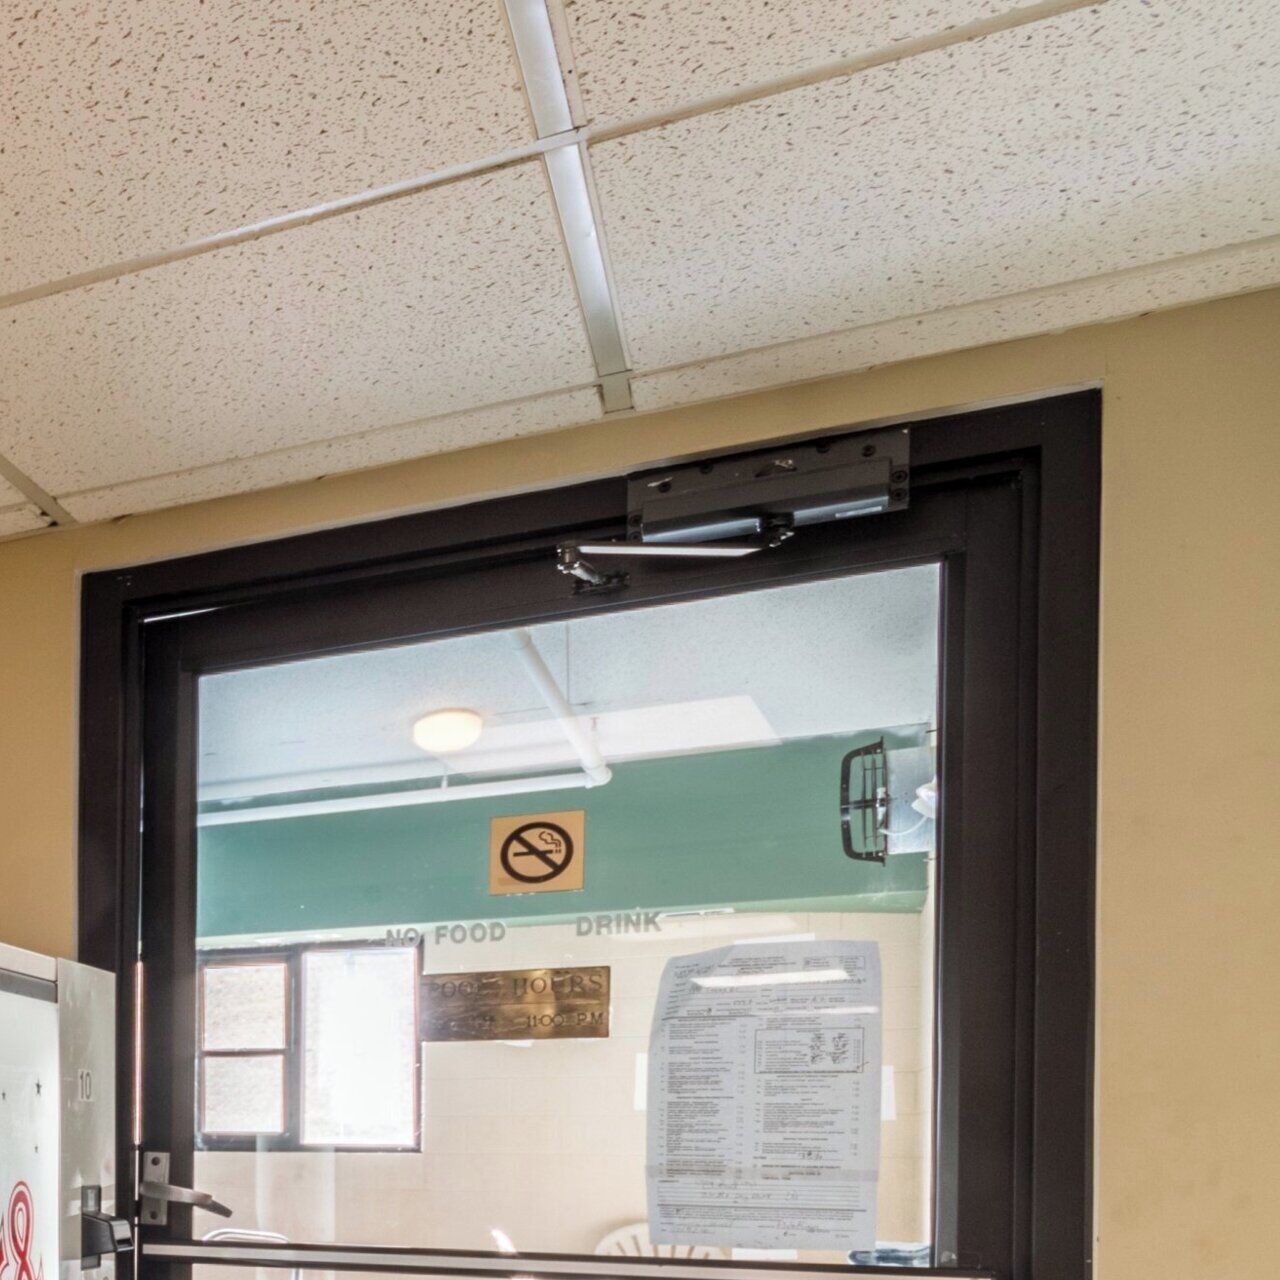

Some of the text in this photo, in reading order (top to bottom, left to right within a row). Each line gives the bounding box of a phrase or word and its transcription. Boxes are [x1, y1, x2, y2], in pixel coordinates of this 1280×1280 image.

[385, 911, 662, 947] NO FOOD DRINK
[513, 974, 603, 997] HOURS
